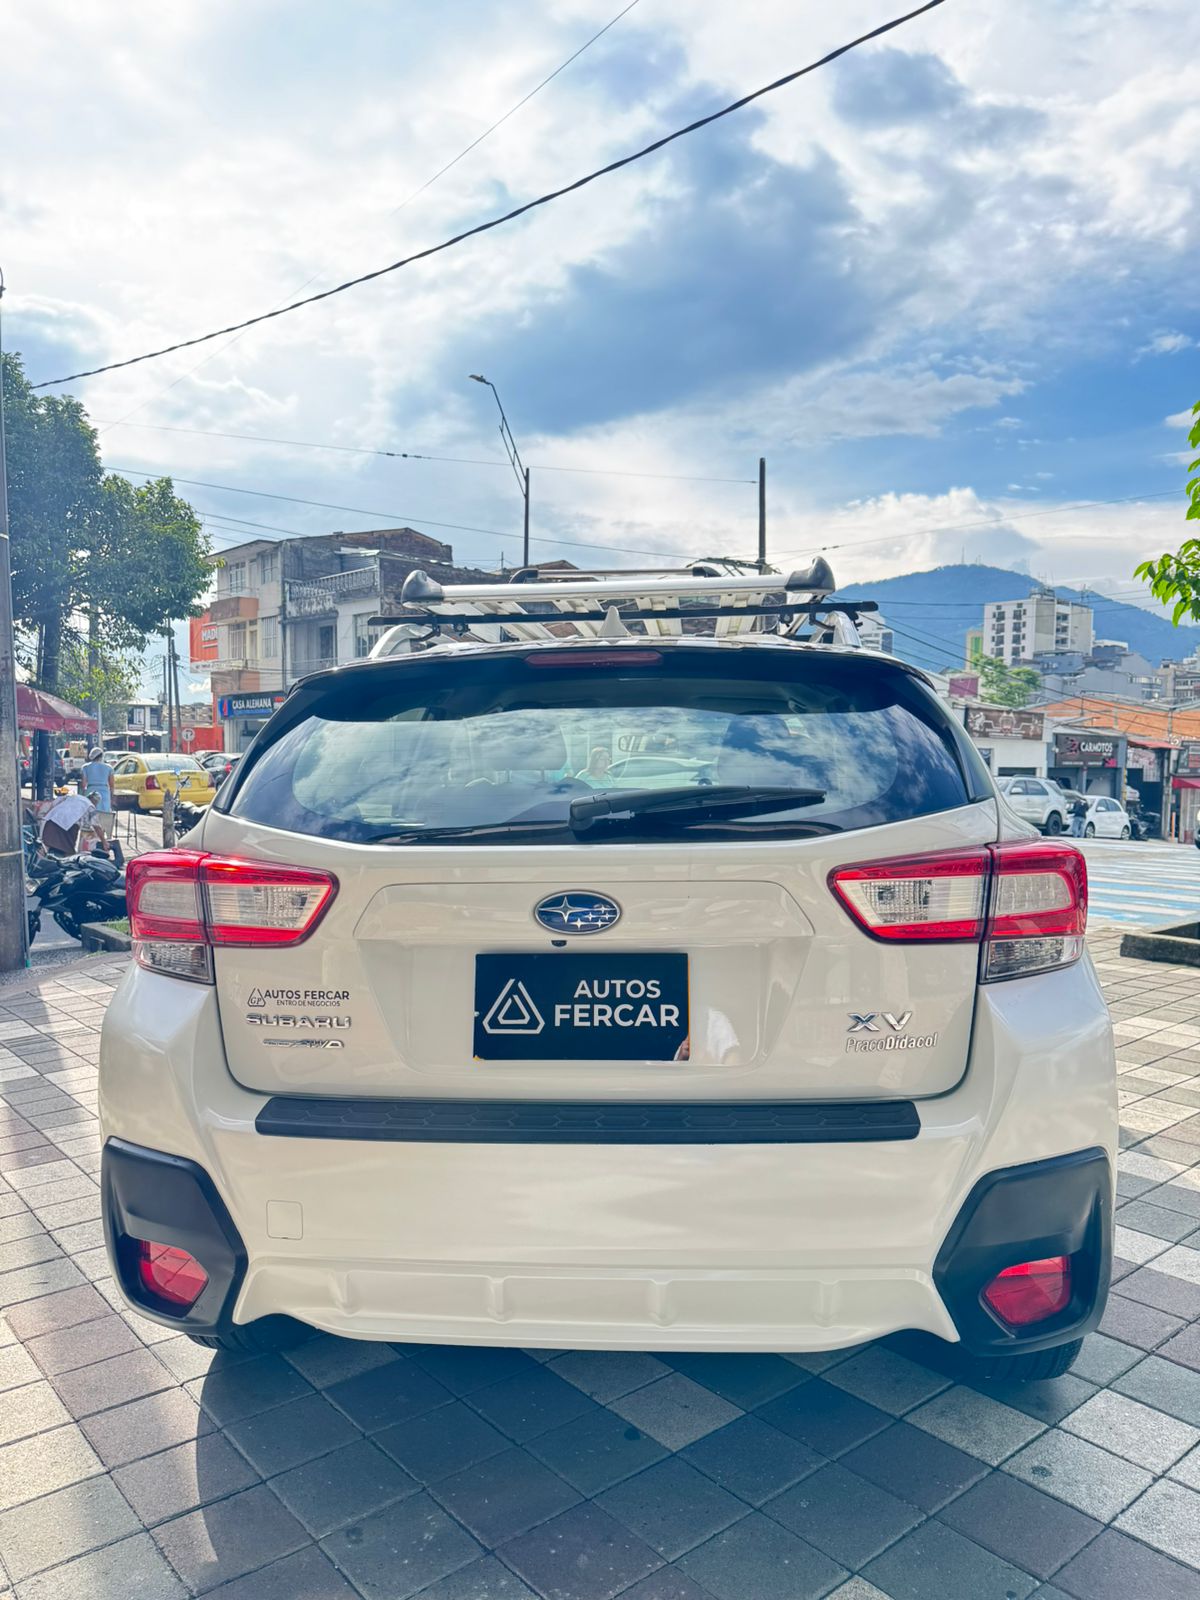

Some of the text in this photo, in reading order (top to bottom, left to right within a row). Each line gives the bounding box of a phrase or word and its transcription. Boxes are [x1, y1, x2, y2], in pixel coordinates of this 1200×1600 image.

[232, 699, 246, 710] CASA
[246, 698, 272, 708] ALEMANA
[1080, 741, 1113, 753] CARMOTOS
[264, 989, 350, 1000] AUTOS FERCAR
[573, 979, 662, 999] AUTOS
[246, 1013, 351, 1029] SUBARU
[553, 1003, 680, 1028] FERCAR
[847, 1011, 913, 1032] XV
[845, 1032, 938, 1053] PracoDidacol
